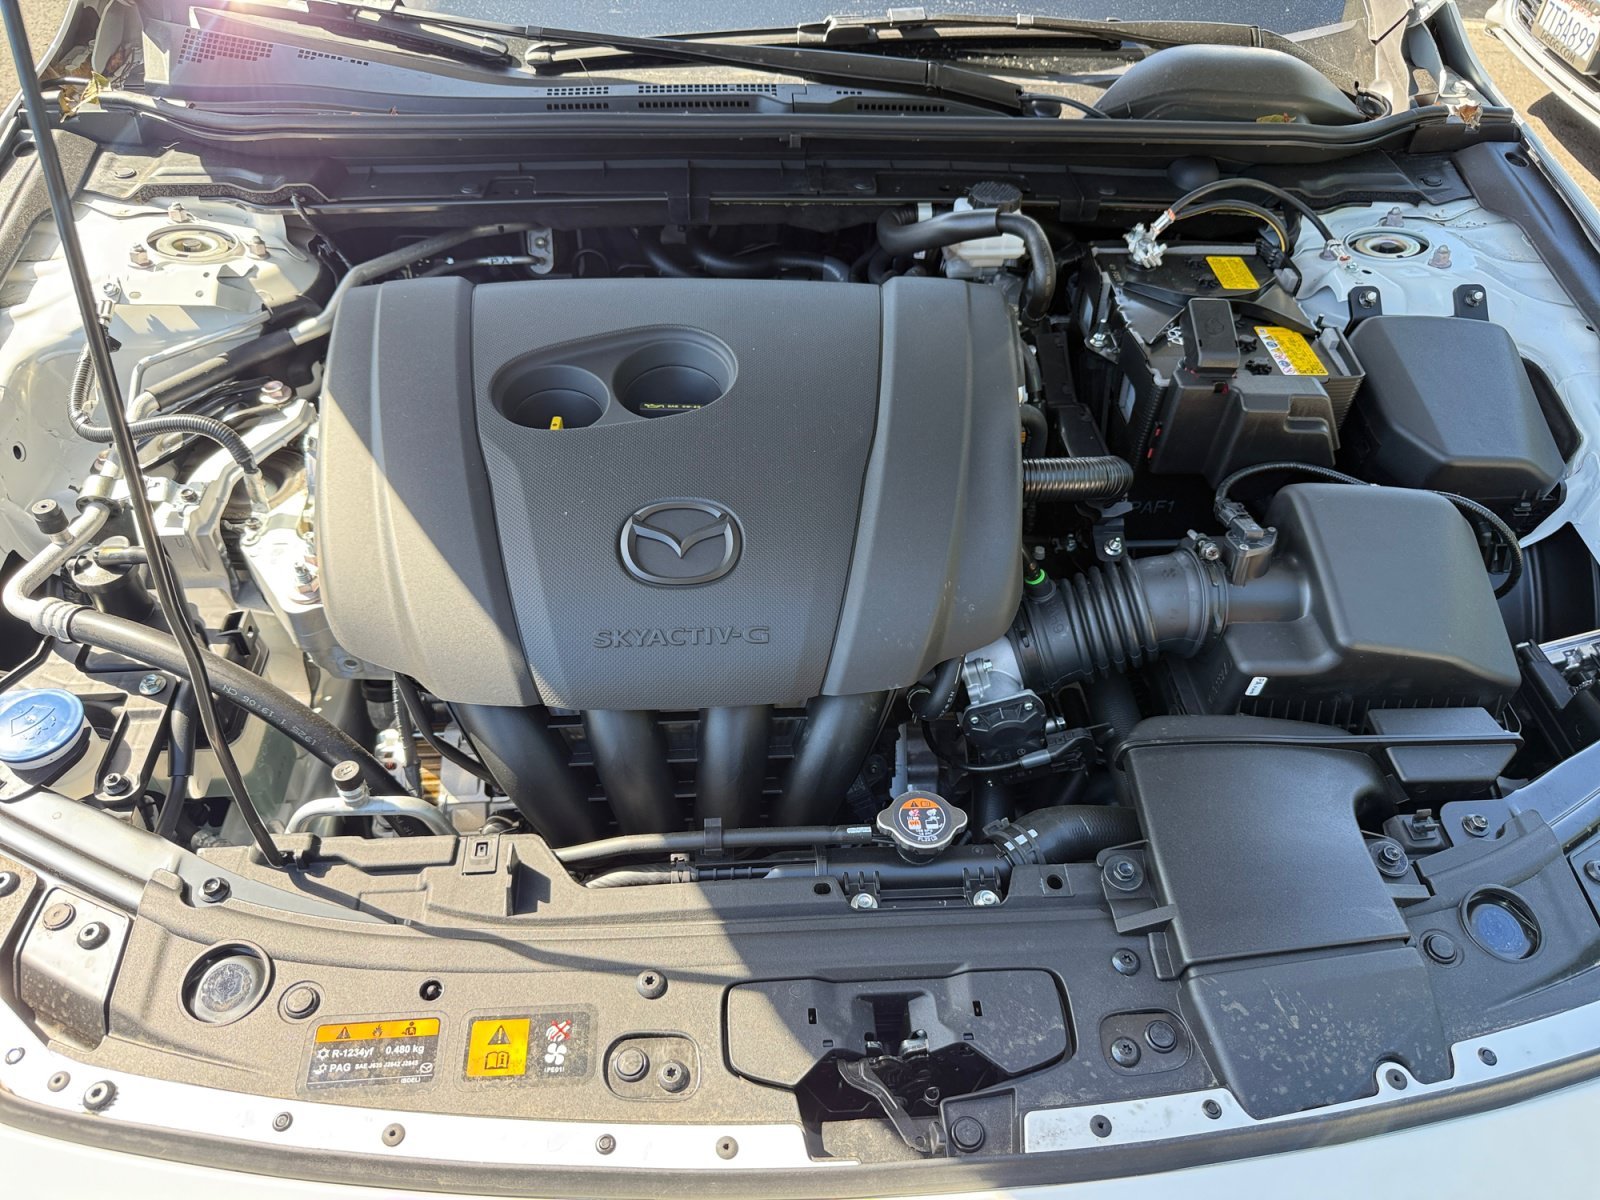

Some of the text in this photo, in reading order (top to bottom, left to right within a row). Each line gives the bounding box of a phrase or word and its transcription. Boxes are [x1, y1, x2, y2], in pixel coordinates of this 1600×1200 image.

[1542, 1, 1595, 58] 7TBA899
[592, 626, 771, 649] SKYACTIV-G
[331, 1044, 425, 1059] R-1234yf 0.480 kg
[329, 1062, 351, 1073] PAG
